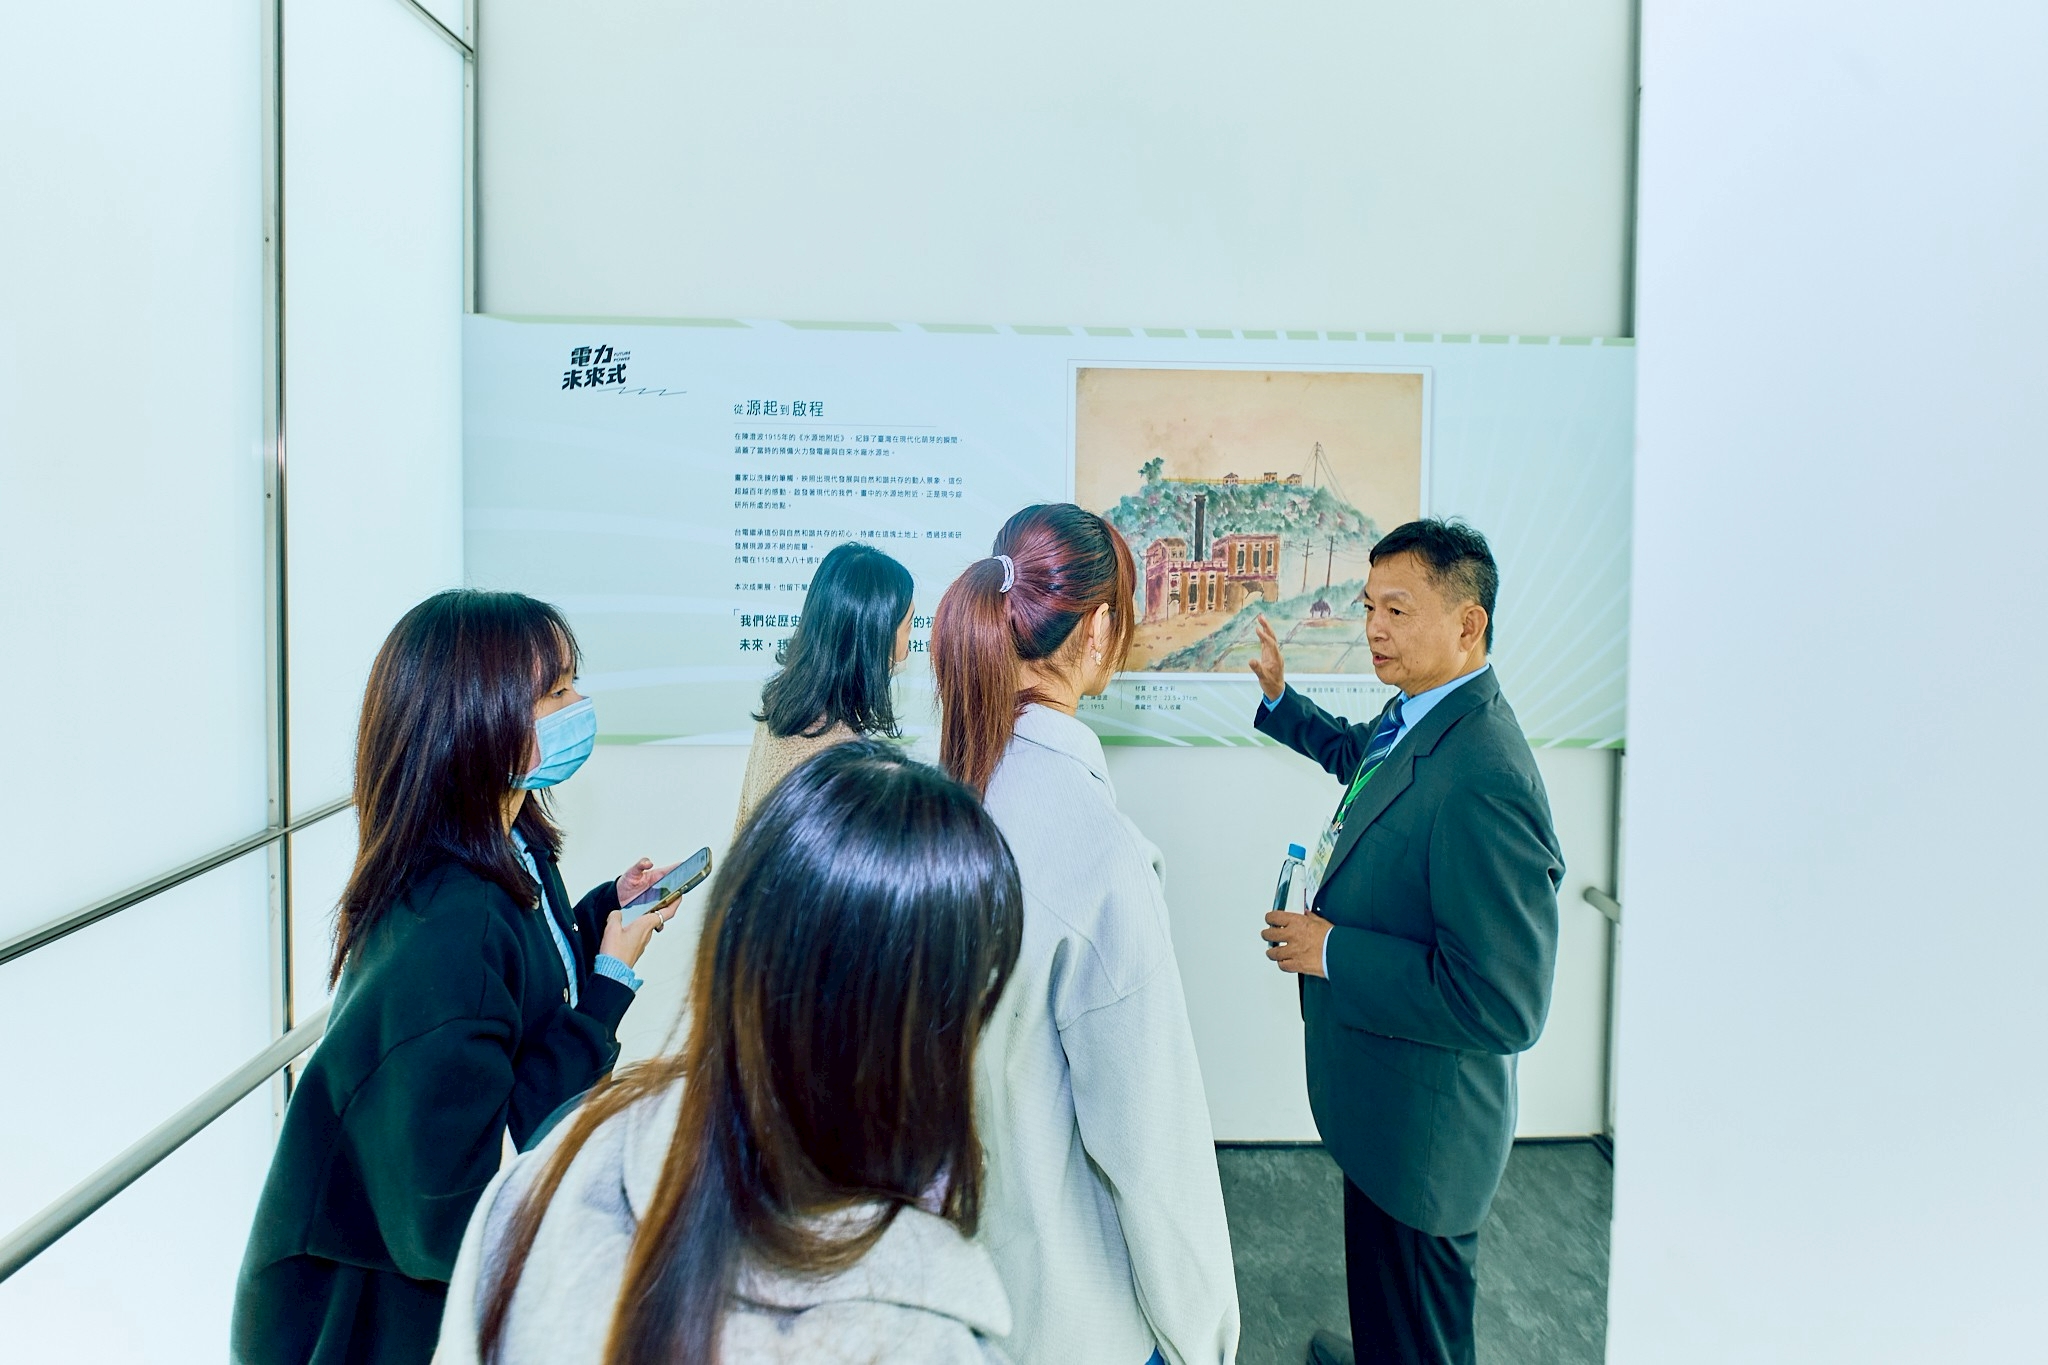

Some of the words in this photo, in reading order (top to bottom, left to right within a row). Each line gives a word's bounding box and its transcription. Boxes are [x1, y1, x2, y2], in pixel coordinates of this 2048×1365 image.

[571, 344, 614, 367] 電力
[562, 363, 627, 390] 未來式
[734, 400, 824, 417] 從源起到啟程
[735, 556, 824, 564] 台電在115年進入八十週年
